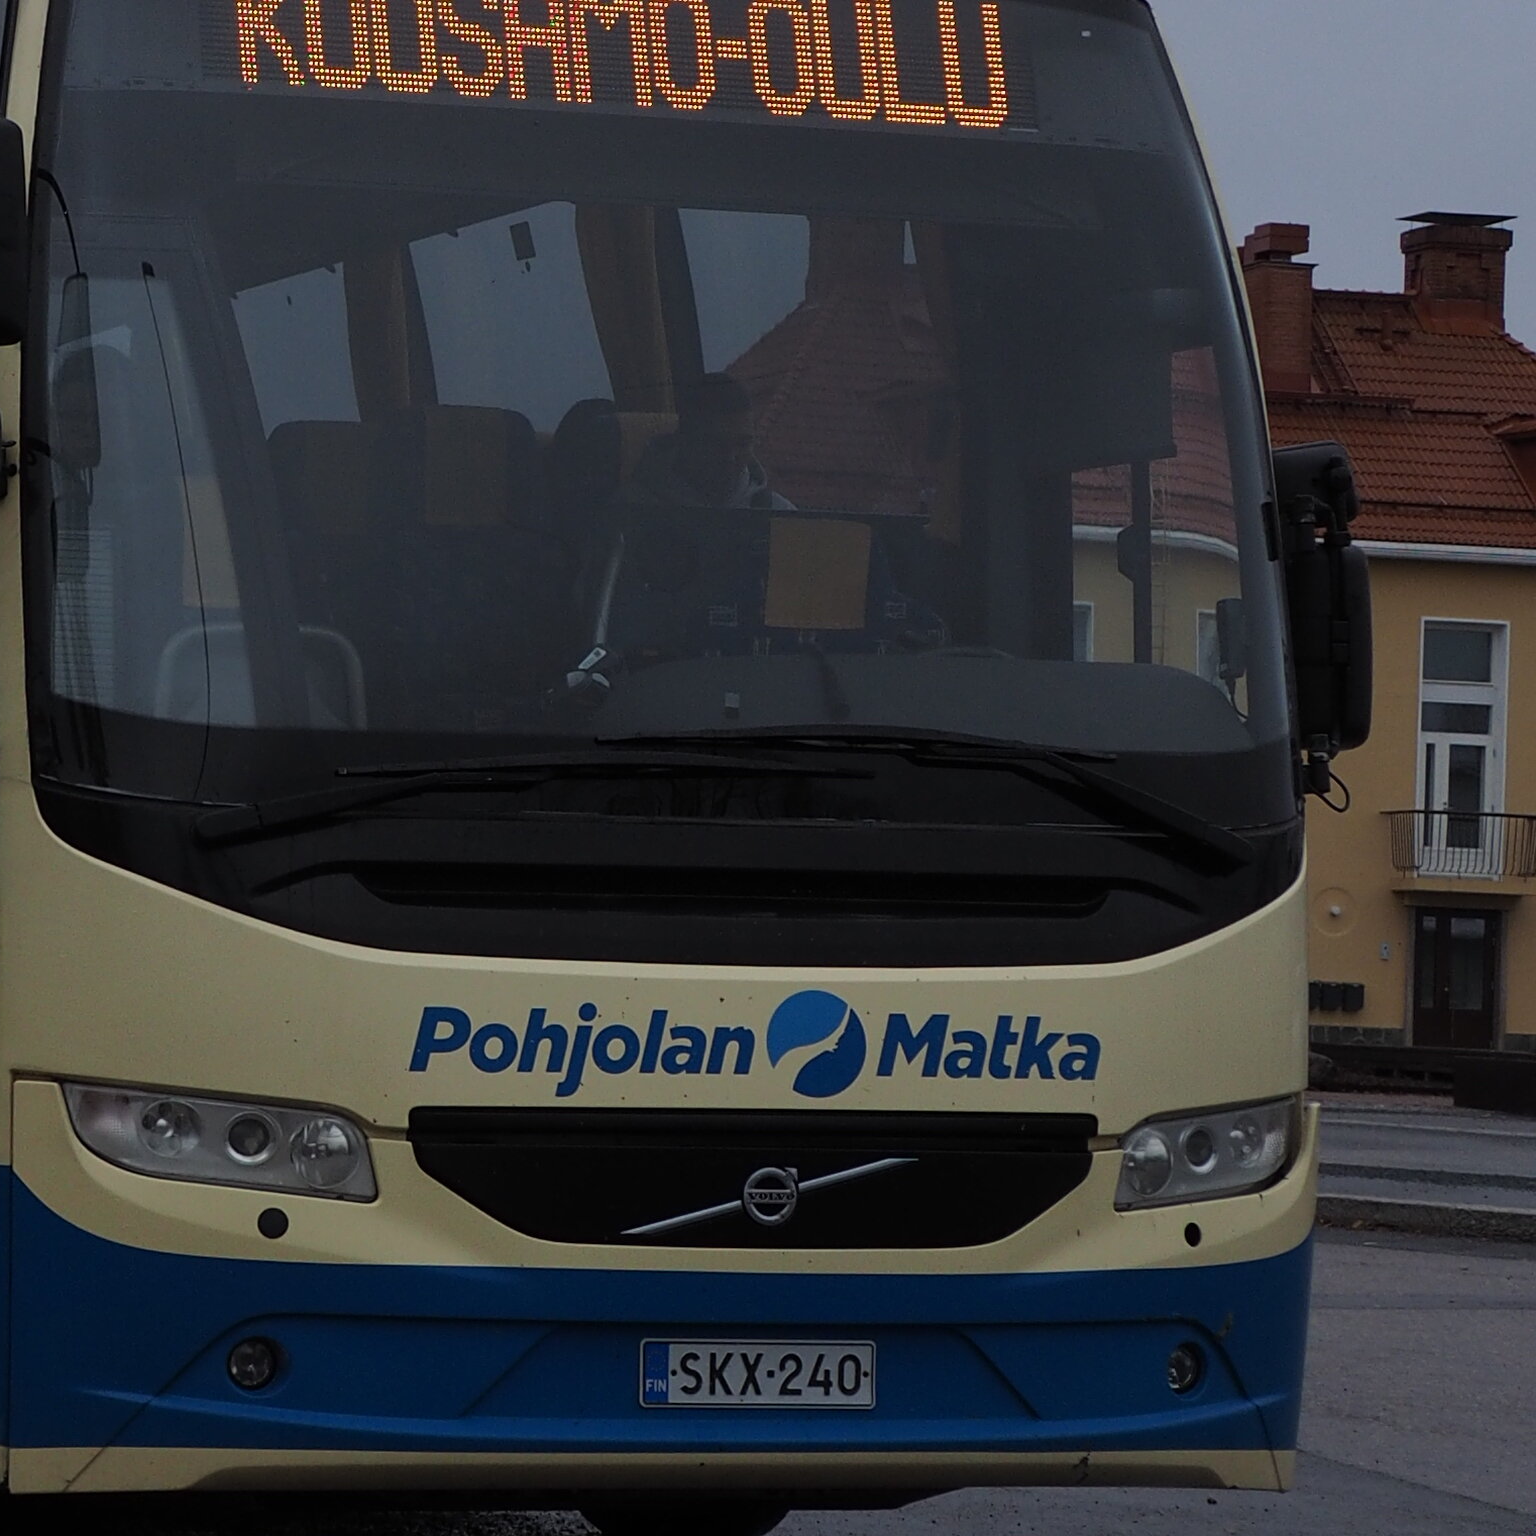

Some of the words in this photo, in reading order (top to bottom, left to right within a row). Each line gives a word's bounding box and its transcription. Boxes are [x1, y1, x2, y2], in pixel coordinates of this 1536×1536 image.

[409, 1002, 755, 1098] Pohjolan
[876, 1013, 1101, 1081] Matka
[748, 1192, 795, 1201] VOLVO
[645, 1378, 667, 1393] FIN
